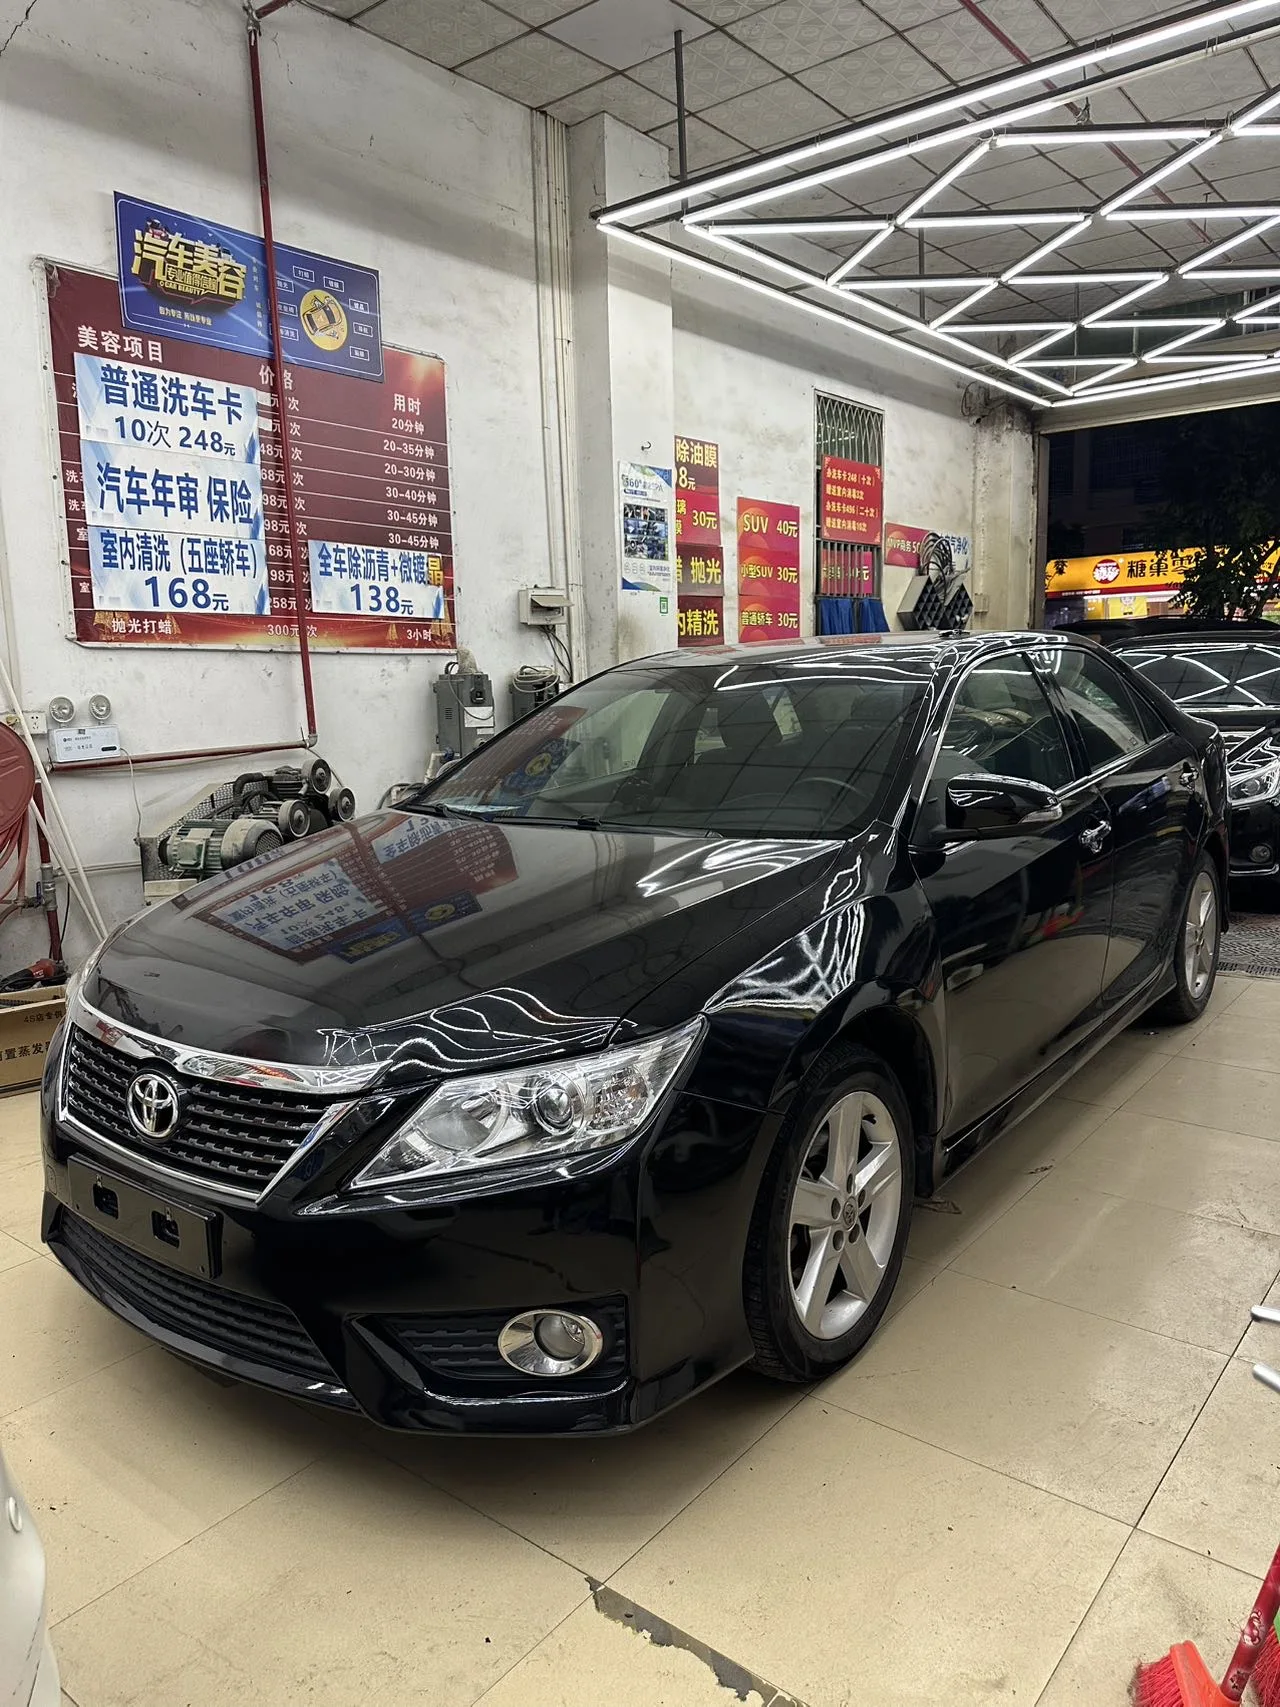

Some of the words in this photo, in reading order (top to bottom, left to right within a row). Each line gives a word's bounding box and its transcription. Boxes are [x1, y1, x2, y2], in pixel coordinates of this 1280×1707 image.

[131, 229, 247, 300] 汽车美容
[77, 325, 163, 363] 美容项目
[394, 393, 421, 415] 用时
[101, 364, 242, 425] 普通洗车卡
[115, 416, 172, 449] 10次
[178, 426, 236, 456] 248元
[391, 418, 424, 435] 20分钟
[383, 440, 434, 460] 20-35分钟
[384, 463, 436, 482] 20-30分钟
[97, 461, 199, 520] 汽车年审
[207, 475, 253, 525] 保险
[386, 487, 436, 505] 30-40分钟
[387, 510, 438, 527] 30-45分钟
[692, 510, 717, 529] 30元
[743, 514, 768, 534] SUV
[776, 520, 798, 538] 40元
[388, 533, 439, 549] 30-45分钟
[690, 556, 721, 584] 抛光
[741, 564, 773, 578] 小型SUV
[777, 566, 798, 583] 30元
[144, 575, 229, 611] 168元
[350, 583, 414, 616] 138元
[111, 618, 172, 636] 抛光打蜡
[406, 628, 433, 642] 3小时
[741, 611, 773, 626] 普通轿车
[777, 612, 798, 629] 30元
